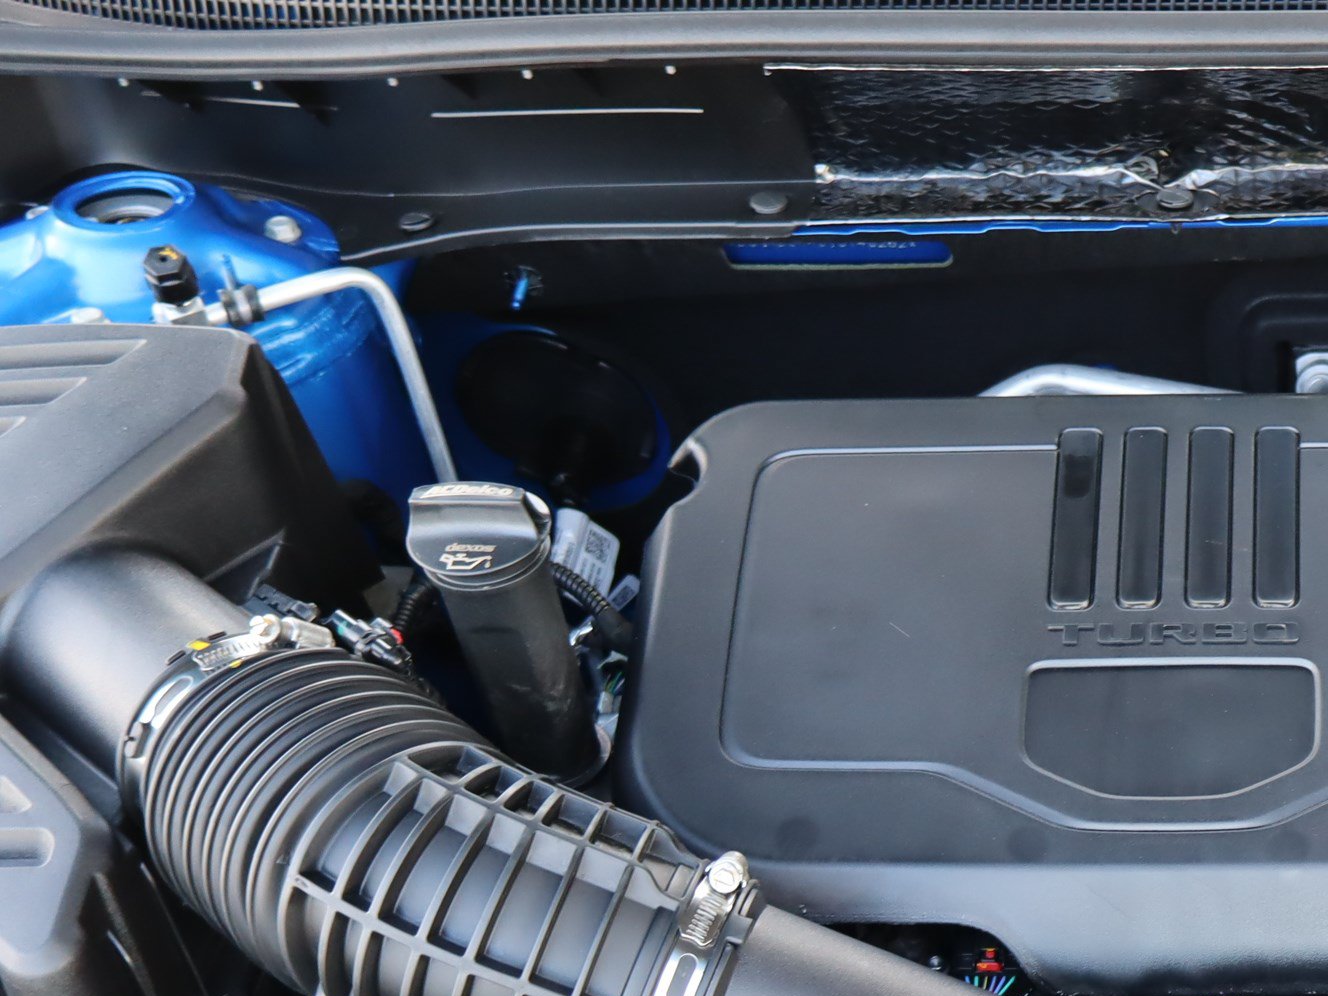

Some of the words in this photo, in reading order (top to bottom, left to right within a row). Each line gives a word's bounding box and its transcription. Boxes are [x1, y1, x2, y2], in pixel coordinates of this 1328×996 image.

[420, 484, 514, 499] ACDelco
[445, 542, 498, 553] dexos
[1047, 622, 1300, 647] TURBO
